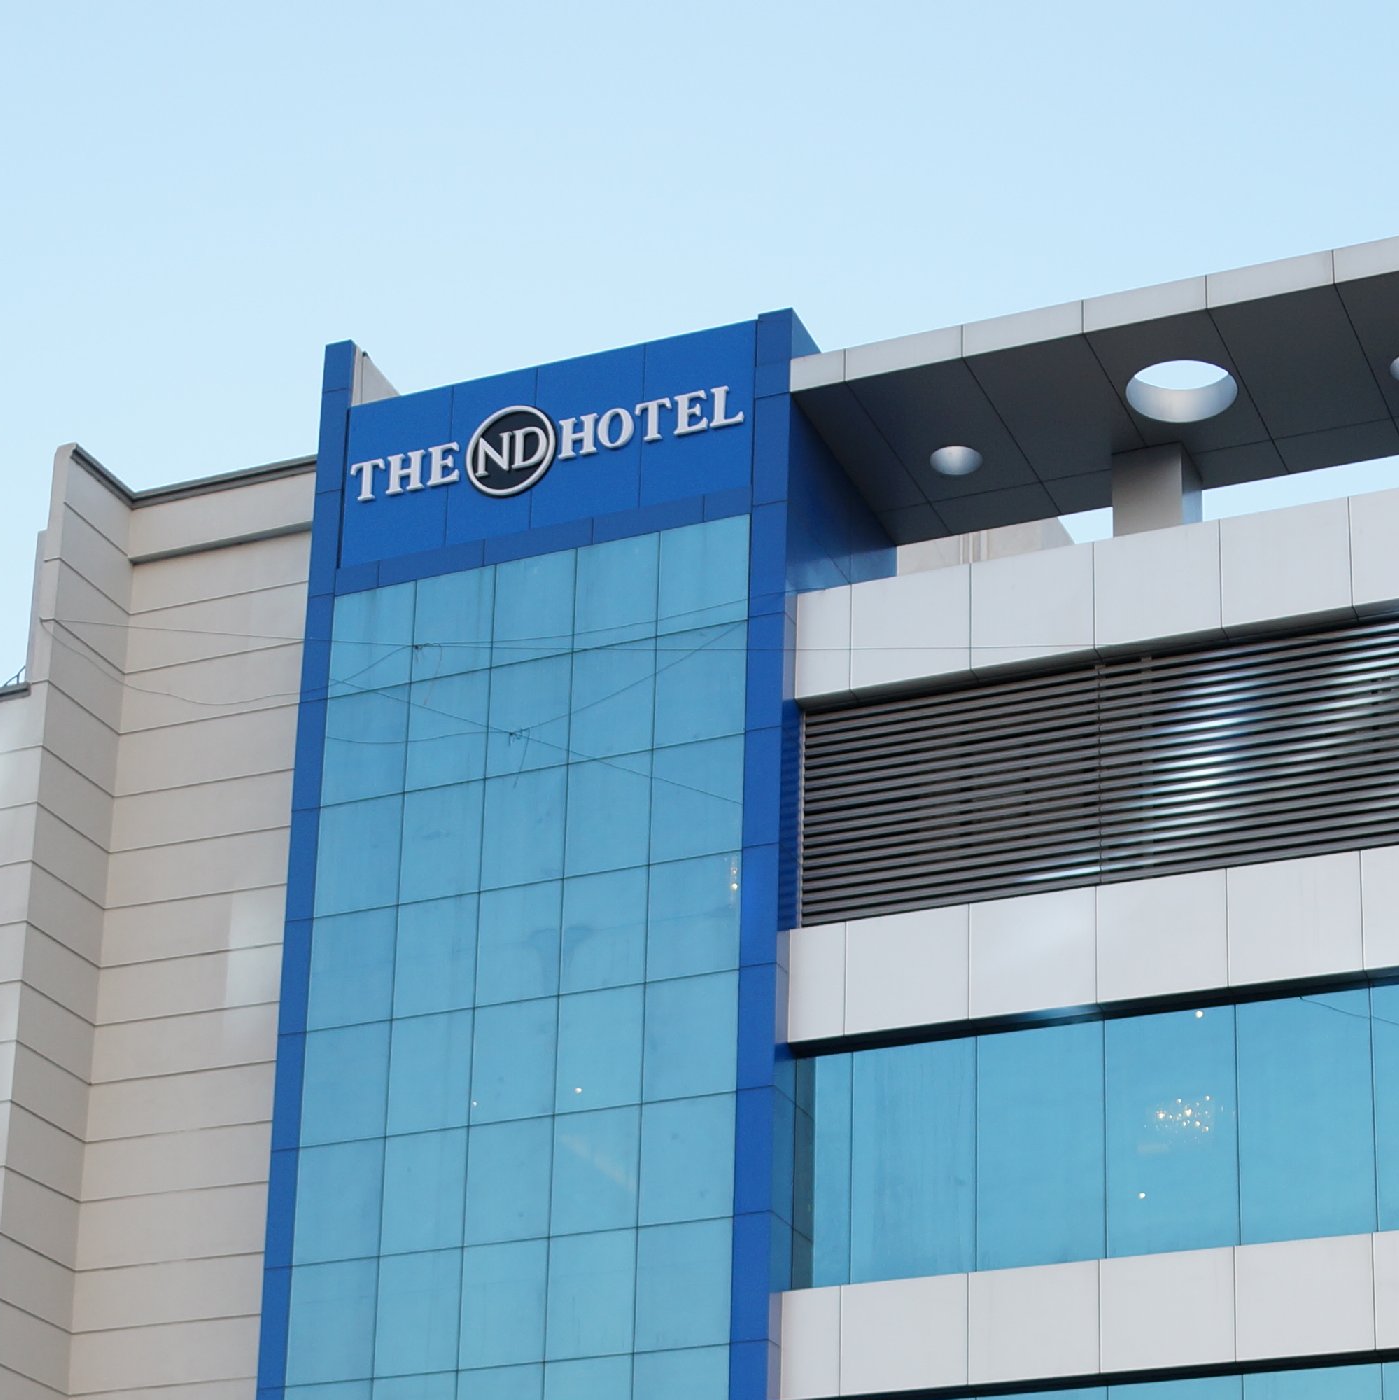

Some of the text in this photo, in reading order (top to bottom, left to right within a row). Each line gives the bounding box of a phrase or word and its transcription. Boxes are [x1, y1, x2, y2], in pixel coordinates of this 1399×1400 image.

[350, 385, 744, 501] THE ND HOTEL
